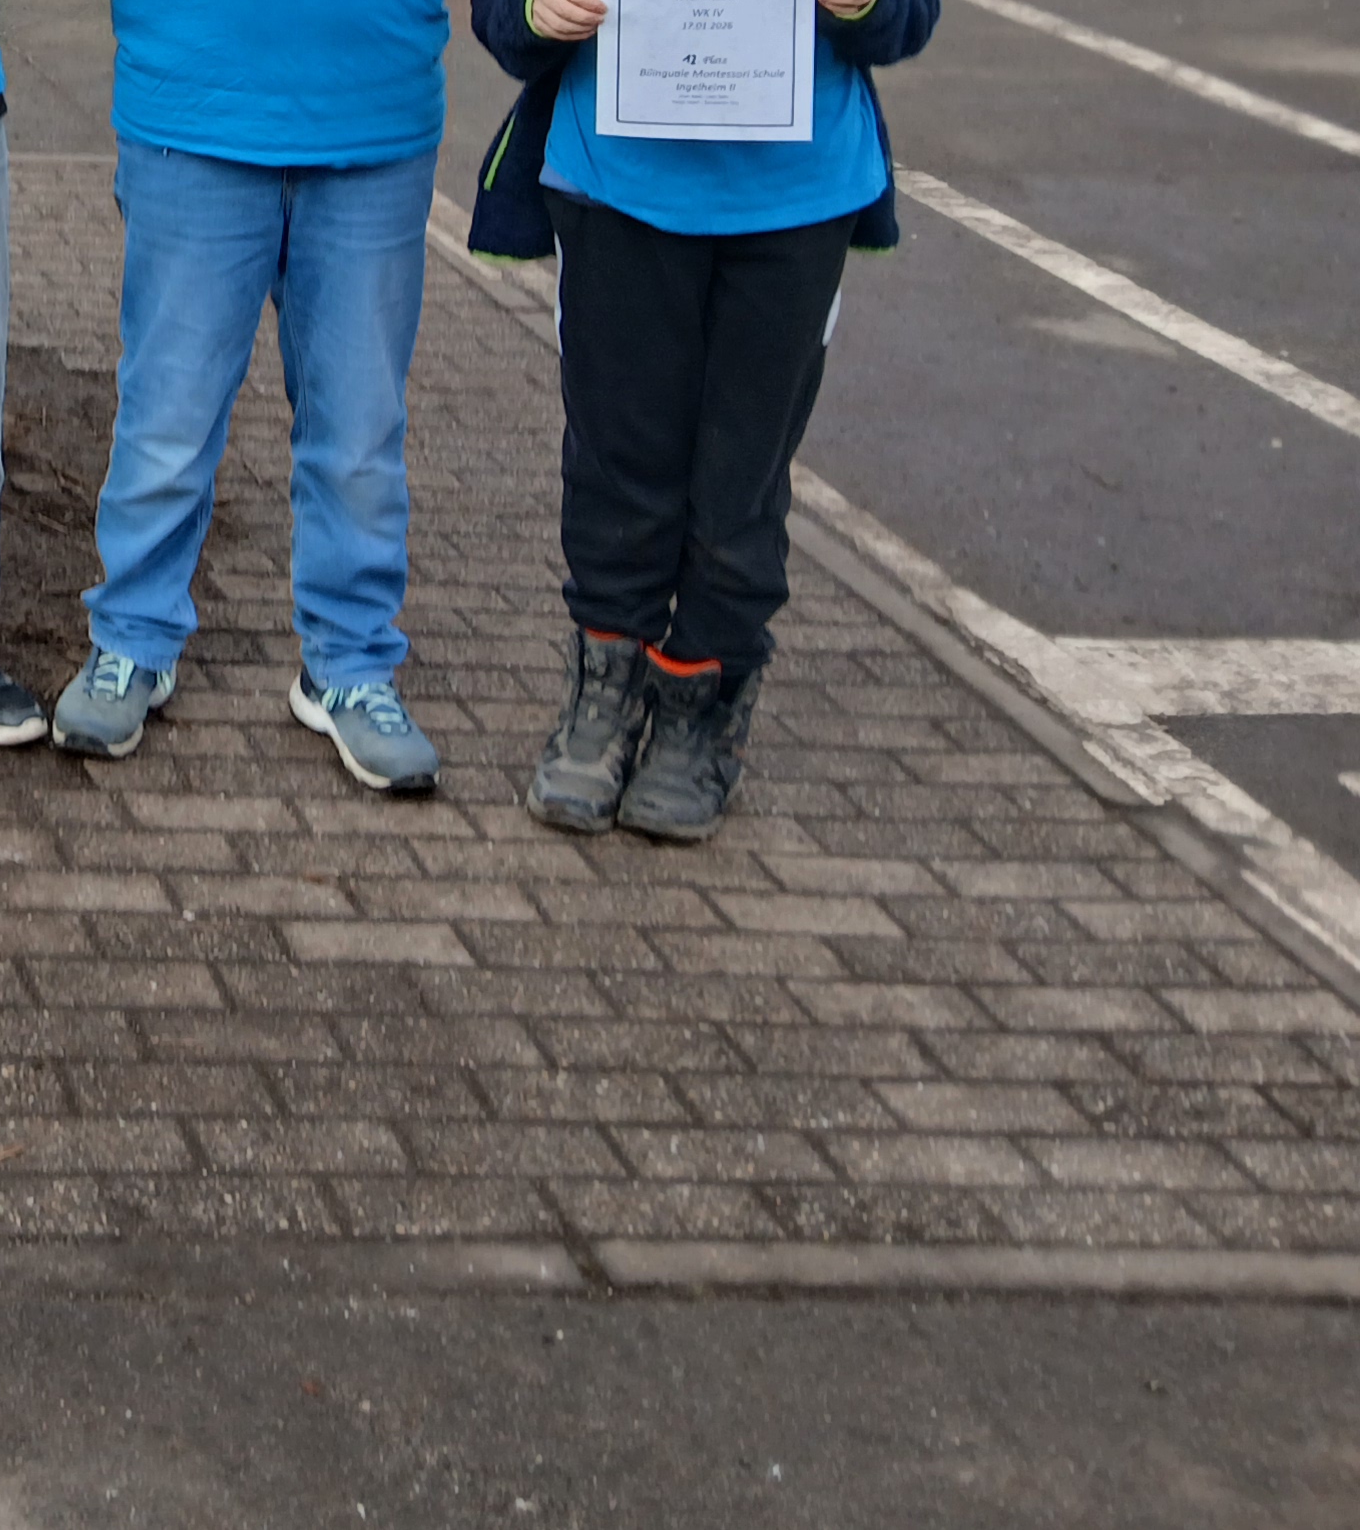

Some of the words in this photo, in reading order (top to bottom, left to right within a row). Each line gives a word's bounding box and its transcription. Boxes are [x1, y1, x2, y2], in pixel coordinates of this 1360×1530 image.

[692, 8, 711, 17] WK
[712, 8, 724, 17] IV
[692, 68, 750, 79] Montessori
[753, 69, 785, 79] Schule
[676, 82, 726, 93] Ingelheim
